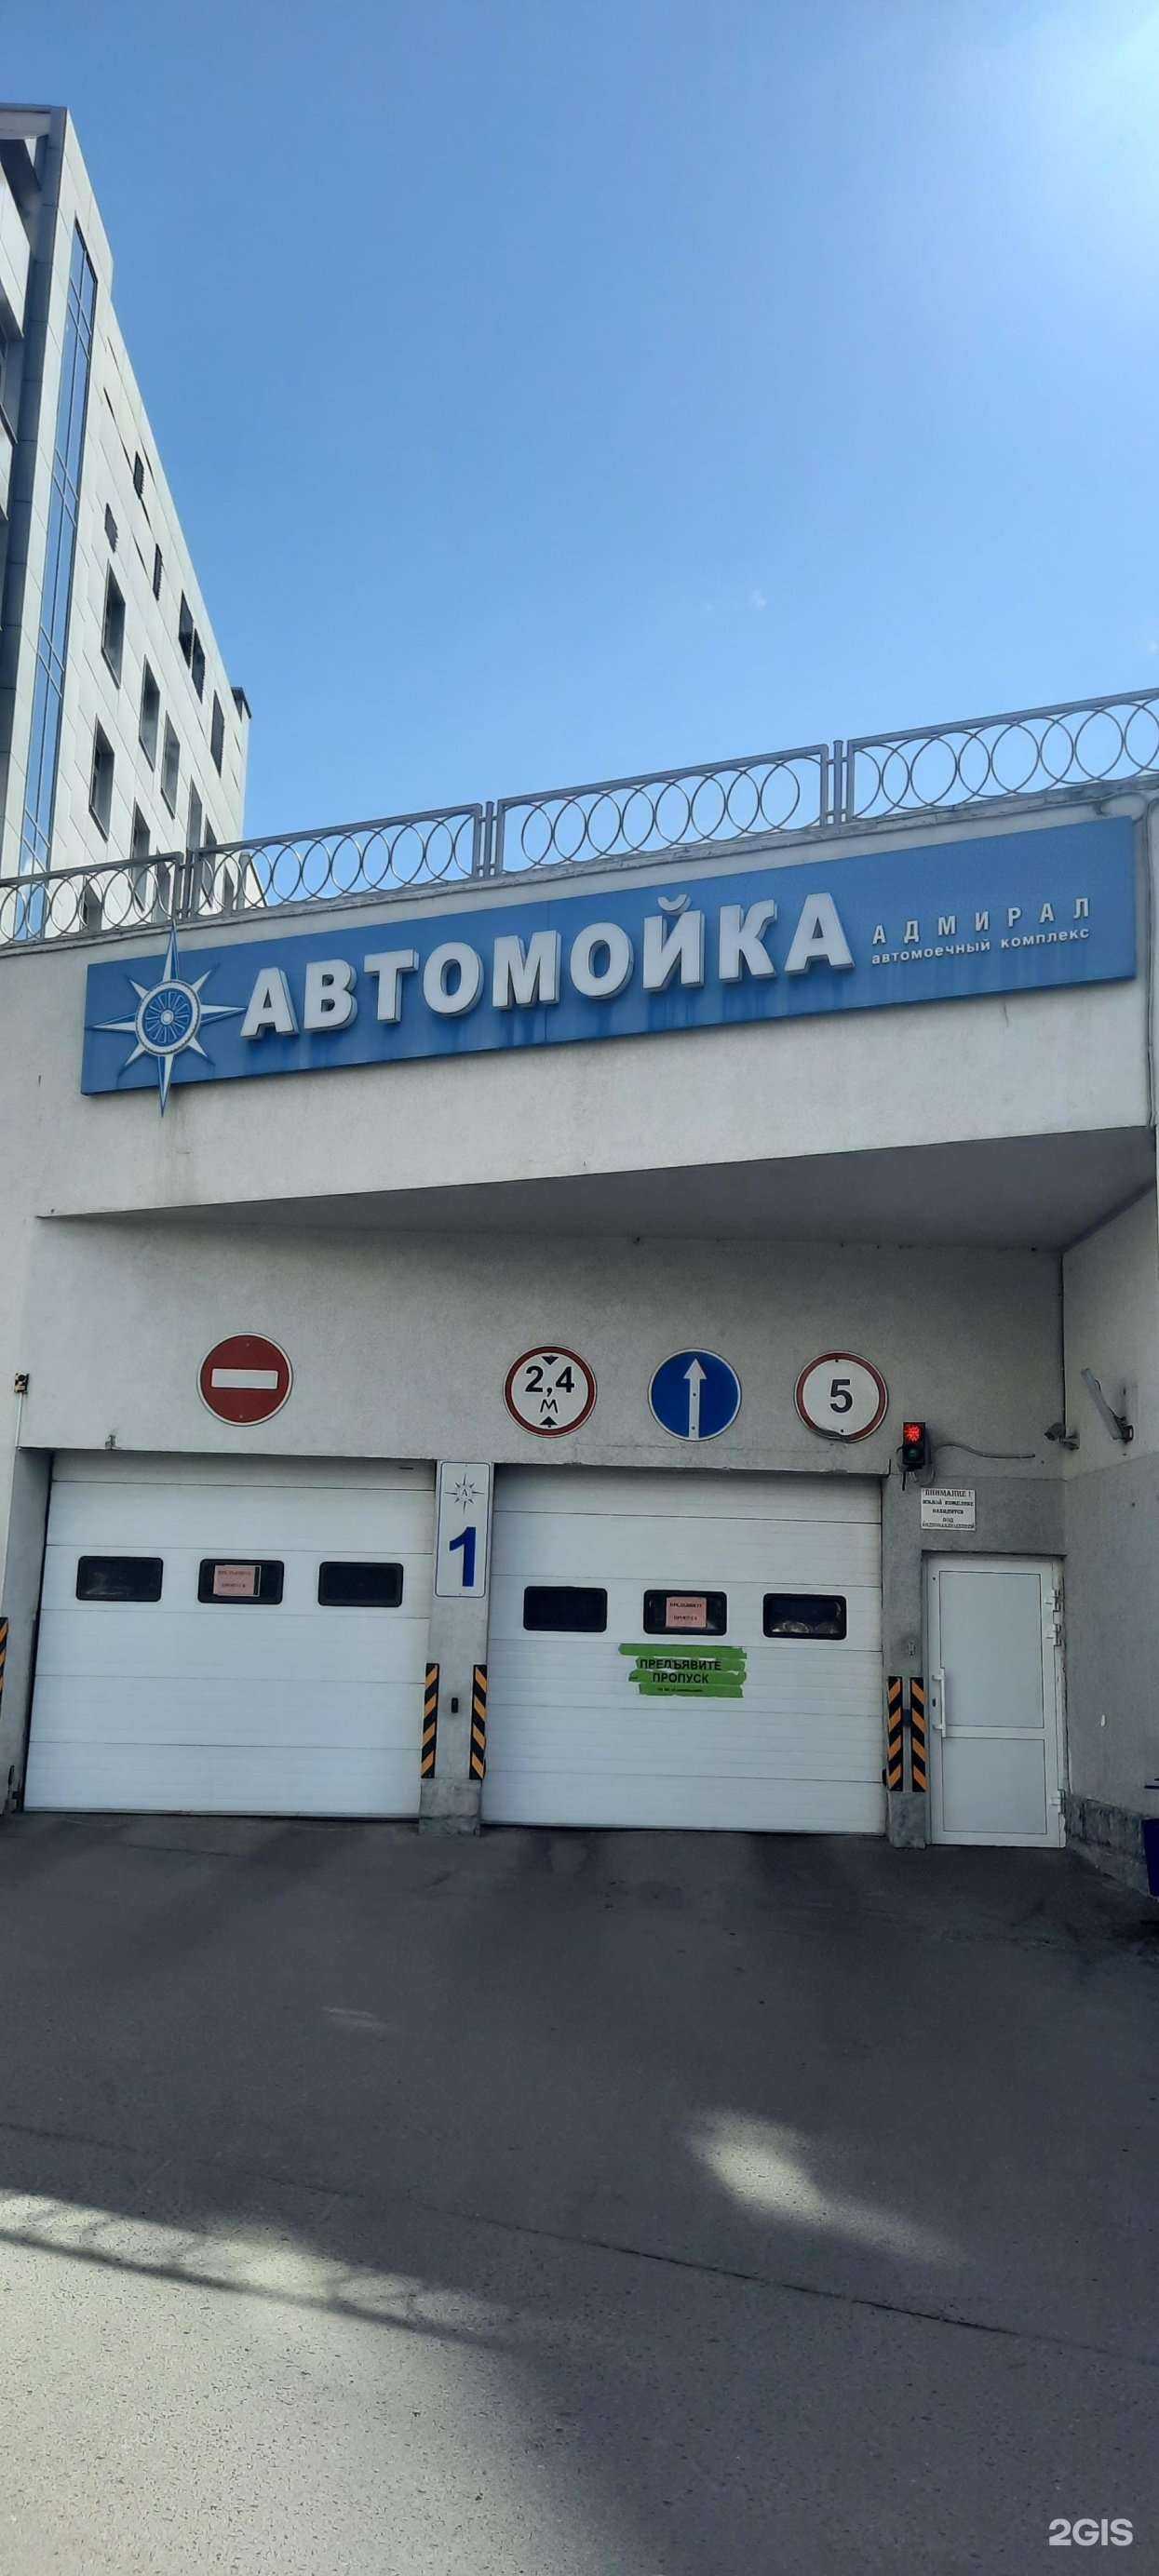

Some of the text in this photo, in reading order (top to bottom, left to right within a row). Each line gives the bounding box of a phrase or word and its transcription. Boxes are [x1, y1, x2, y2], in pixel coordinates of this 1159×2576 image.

[871, 898, 1089, 946] АДМИРАЛ
[871, 928, 1090, 965] автомоечный комплекс
[240, 892, 855, 1040] АВТОМОЙКА
[525, 1365, 574, 1398] 2,4
[829, 1379, 853, 1413] 5
[449, 1526, 476, 1587] 1
[640, 1658, 722, 1670] ПРЕДЪЯВИТЕ
[653, 1672, 708, 1684] ПРОПУСК
